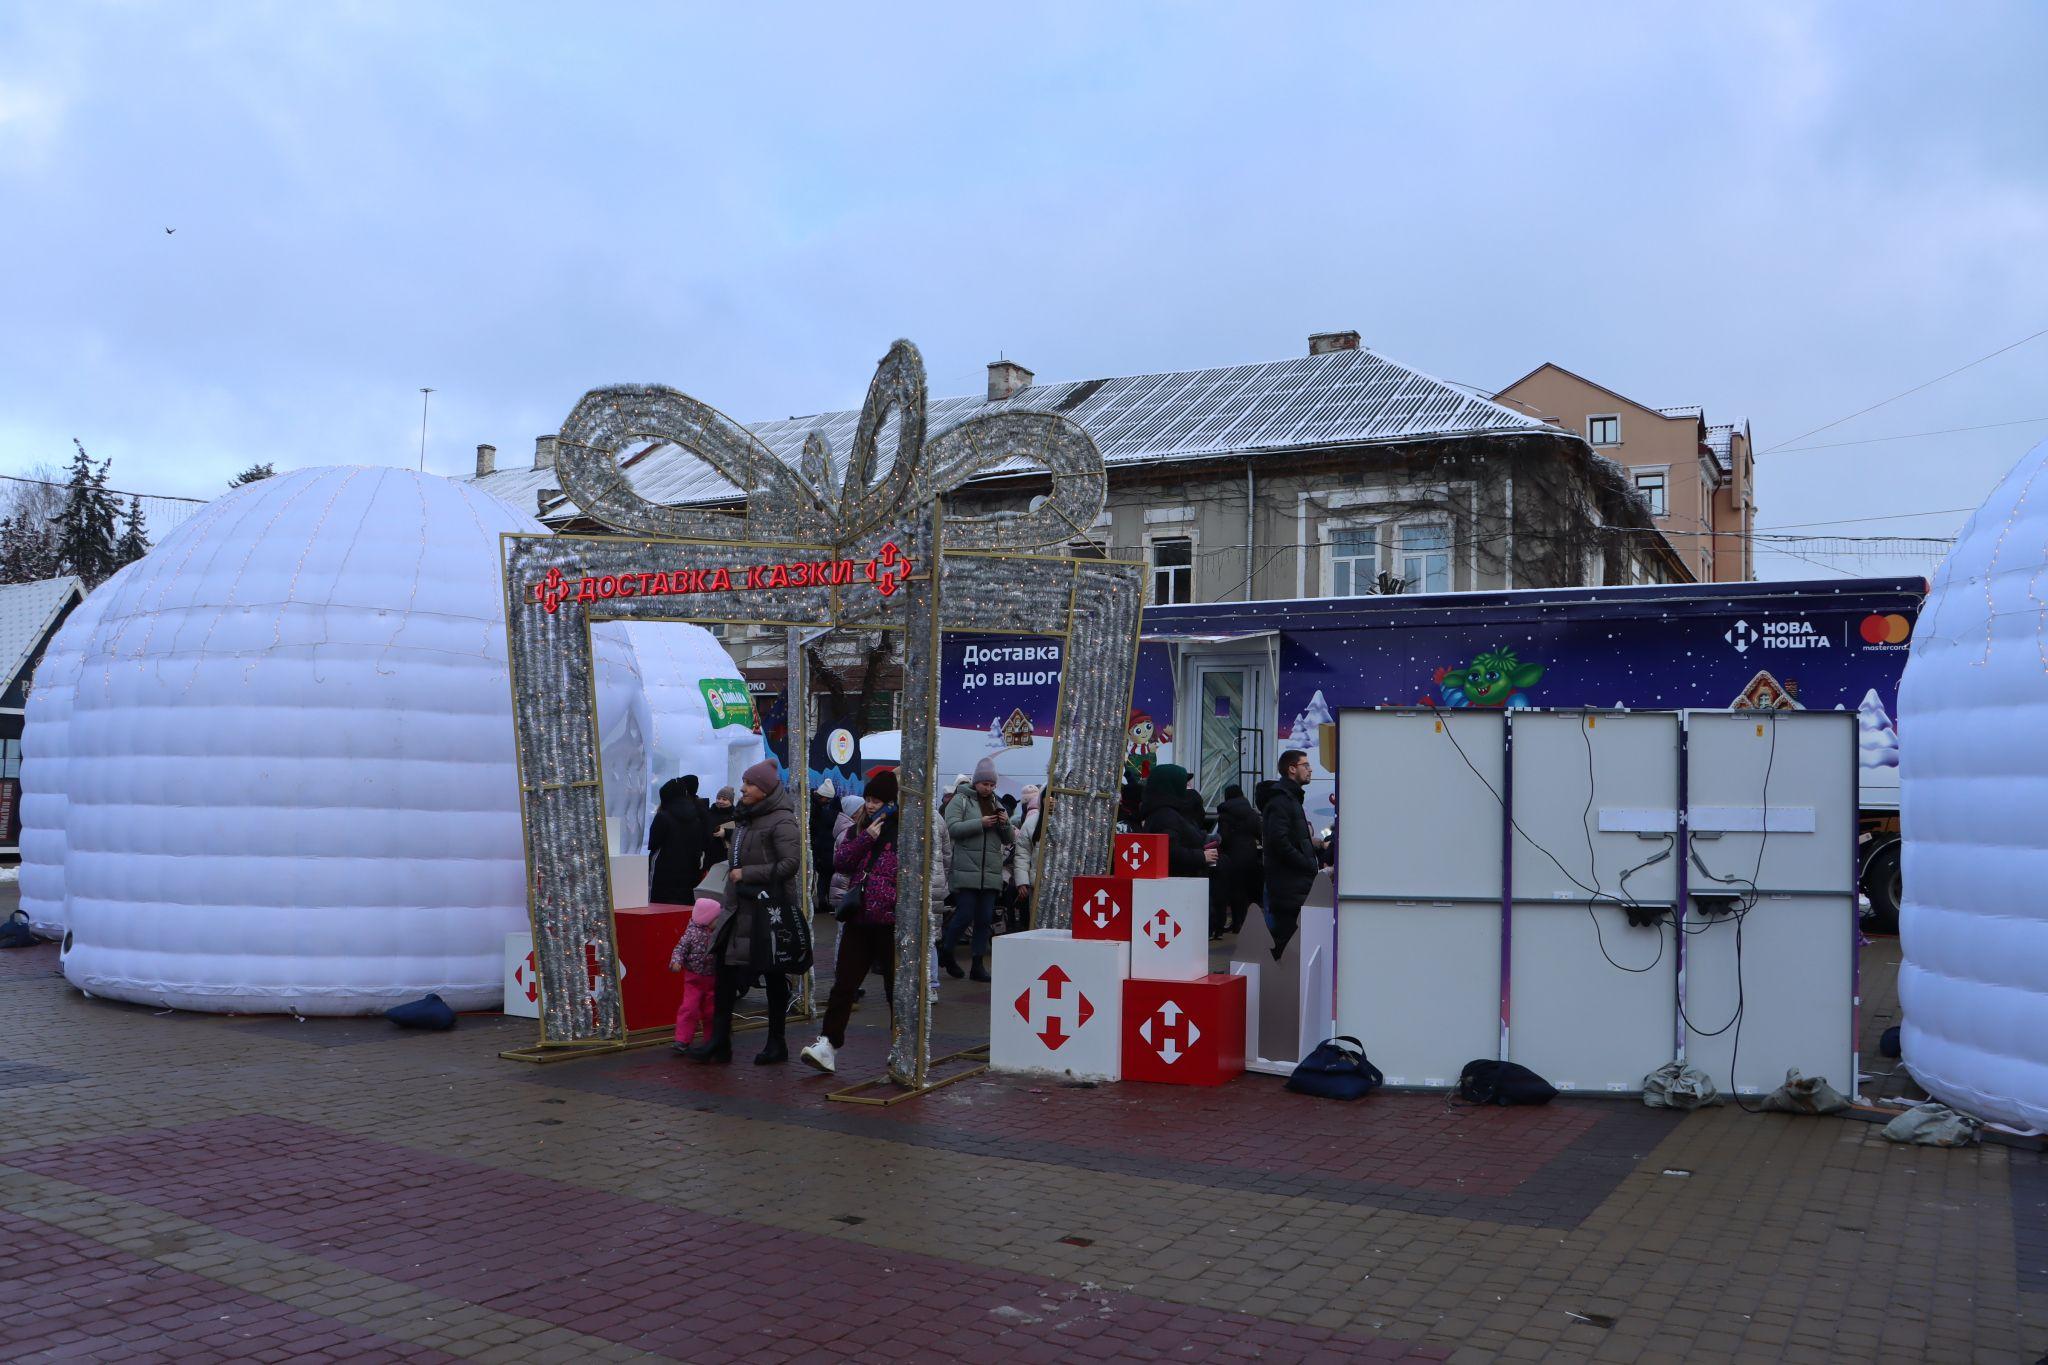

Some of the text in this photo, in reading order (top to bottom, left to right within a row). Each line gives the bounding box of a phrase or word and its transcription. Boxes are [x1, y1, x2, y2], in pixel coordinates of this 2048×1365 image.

[577, 559, 854, 605] ДОСТАВКА КАЗКИ
[1763, 622, 1813, 634] НОВА
[1762, 636, 1831, 649] ПОШТА
[963, 645, 1060, 666] Доставка
[962, 673, 987, 690] до
